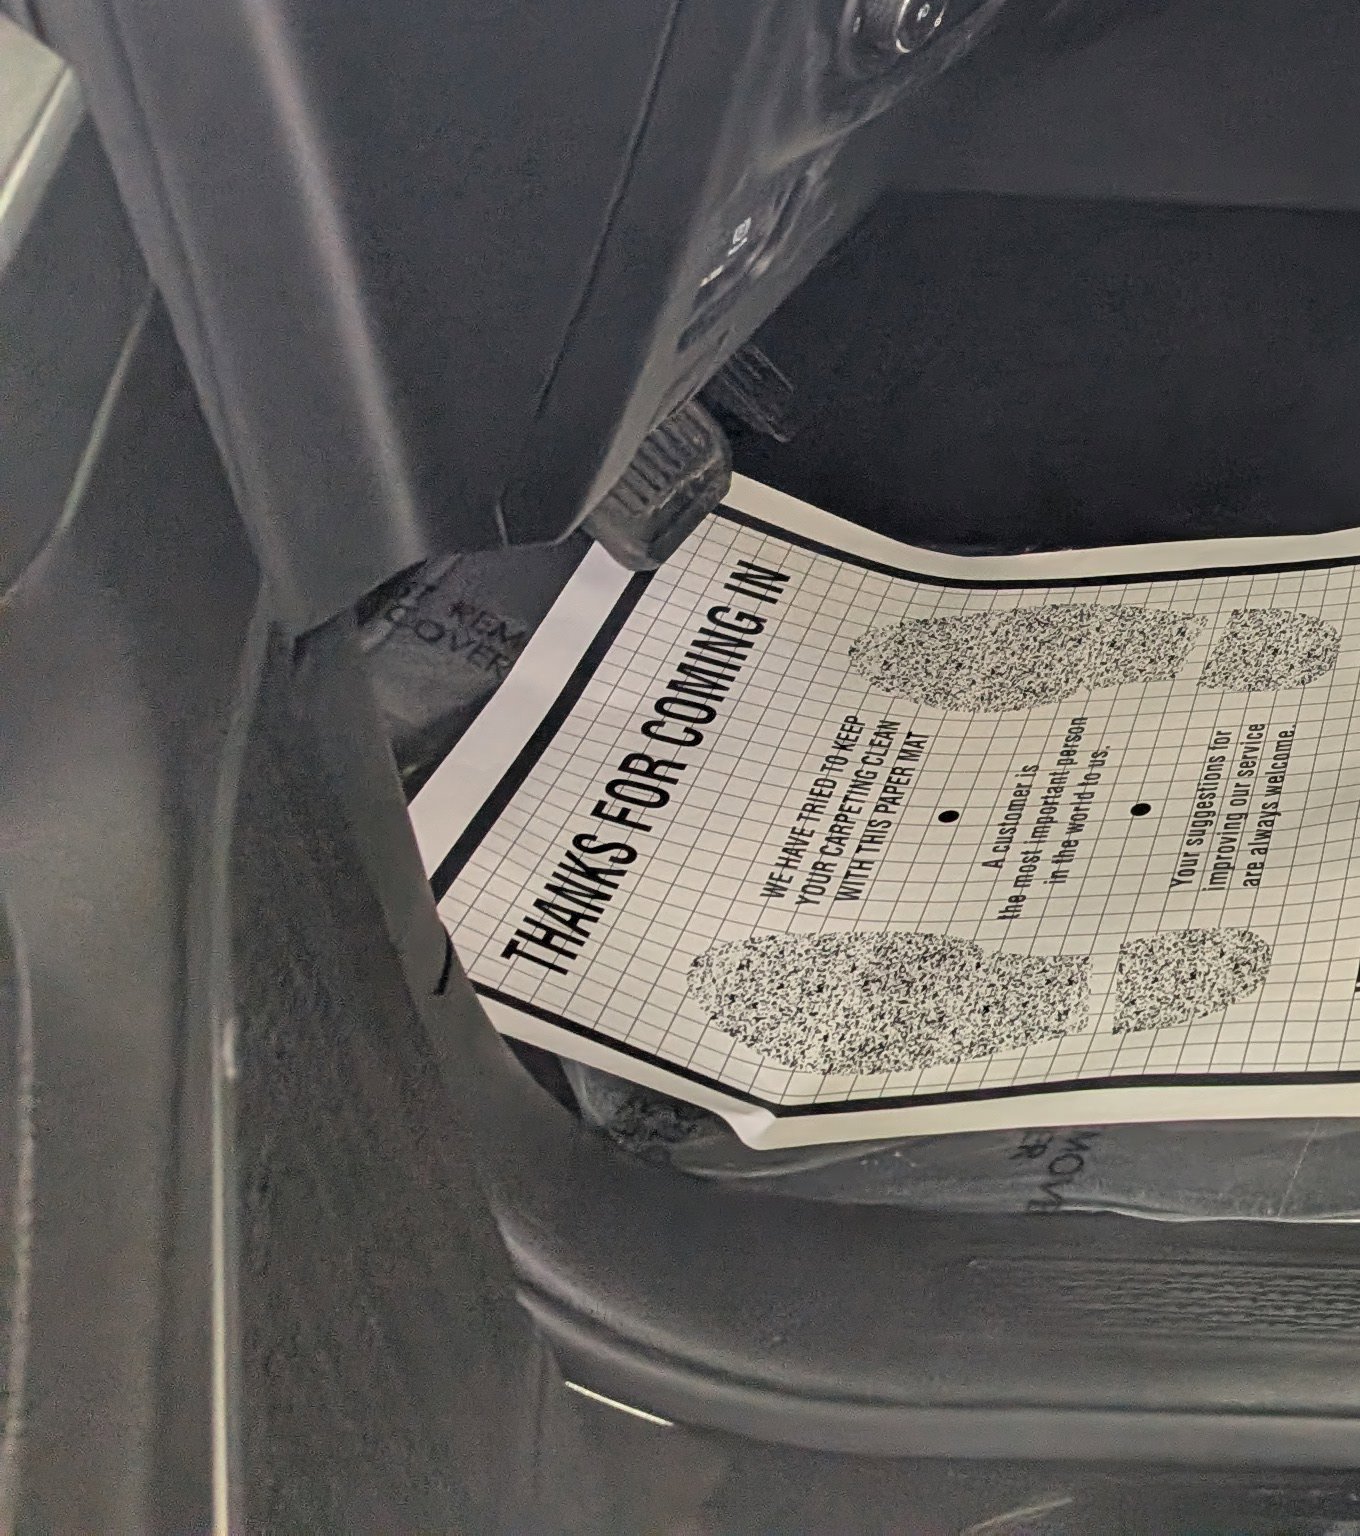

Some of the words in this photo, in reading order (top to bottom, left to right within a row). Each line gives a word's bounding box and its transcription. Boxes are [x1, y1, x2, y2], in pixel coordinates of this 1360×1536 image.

[831, 715, 866, 752] KEEP
[1056, 717, 1089, 765] person
[1237, 723, 1265, 778] service
[500, 833, 638, 976] THANKS
[590, 753, 689, 833] FOR
[641, 605, 769, 748] COMING
[723, 559, 791, 605] IN
[820, 754, 849, 772] TO
[1015, 764, 1040, 777] is
[1088, 745, 1111, 767] us.
[1265, 723, 1297, 798] welcome.
[796, 777, 837, 822] TRIED
[1078, 772, 1101, 786] to
[1230, 782, 1251, 807] our
[795, 860, 837, 905] YOUR
[819, 769, 878, 857] CARPETING
[861, 720, 901, 766] CLEAN
[834, 860, 875, 901] WITH
[855, 819, 892, 853] THIS
[874, 766, 916, 814] PAPER
[897, 731, 929, 762] MAT
[992, 782, 1032, 854] customer
[1023, 770, 1070, 844] important
[1065, 791, 1095, 835] world
[1170, 851, 1200, 889] Your
[1186, 755, 1226, 846] suggestions
[1208, 730, 1232, 751] for
[1247, 802, 1281, 856] always
[774, 826, 815, 870] HAVE
[981, 858, 1005, 869] A
[1013, 849, 1042, 888] most
[1051, 839, 1079, 865] the
[1202, 812, 1248, 891] improving
[760, 871, 794, 898] WE
[1043, 869, 1069, 884] in
[1242, 860, 1264, 887] are
[996, 894, 1027, 920] the
